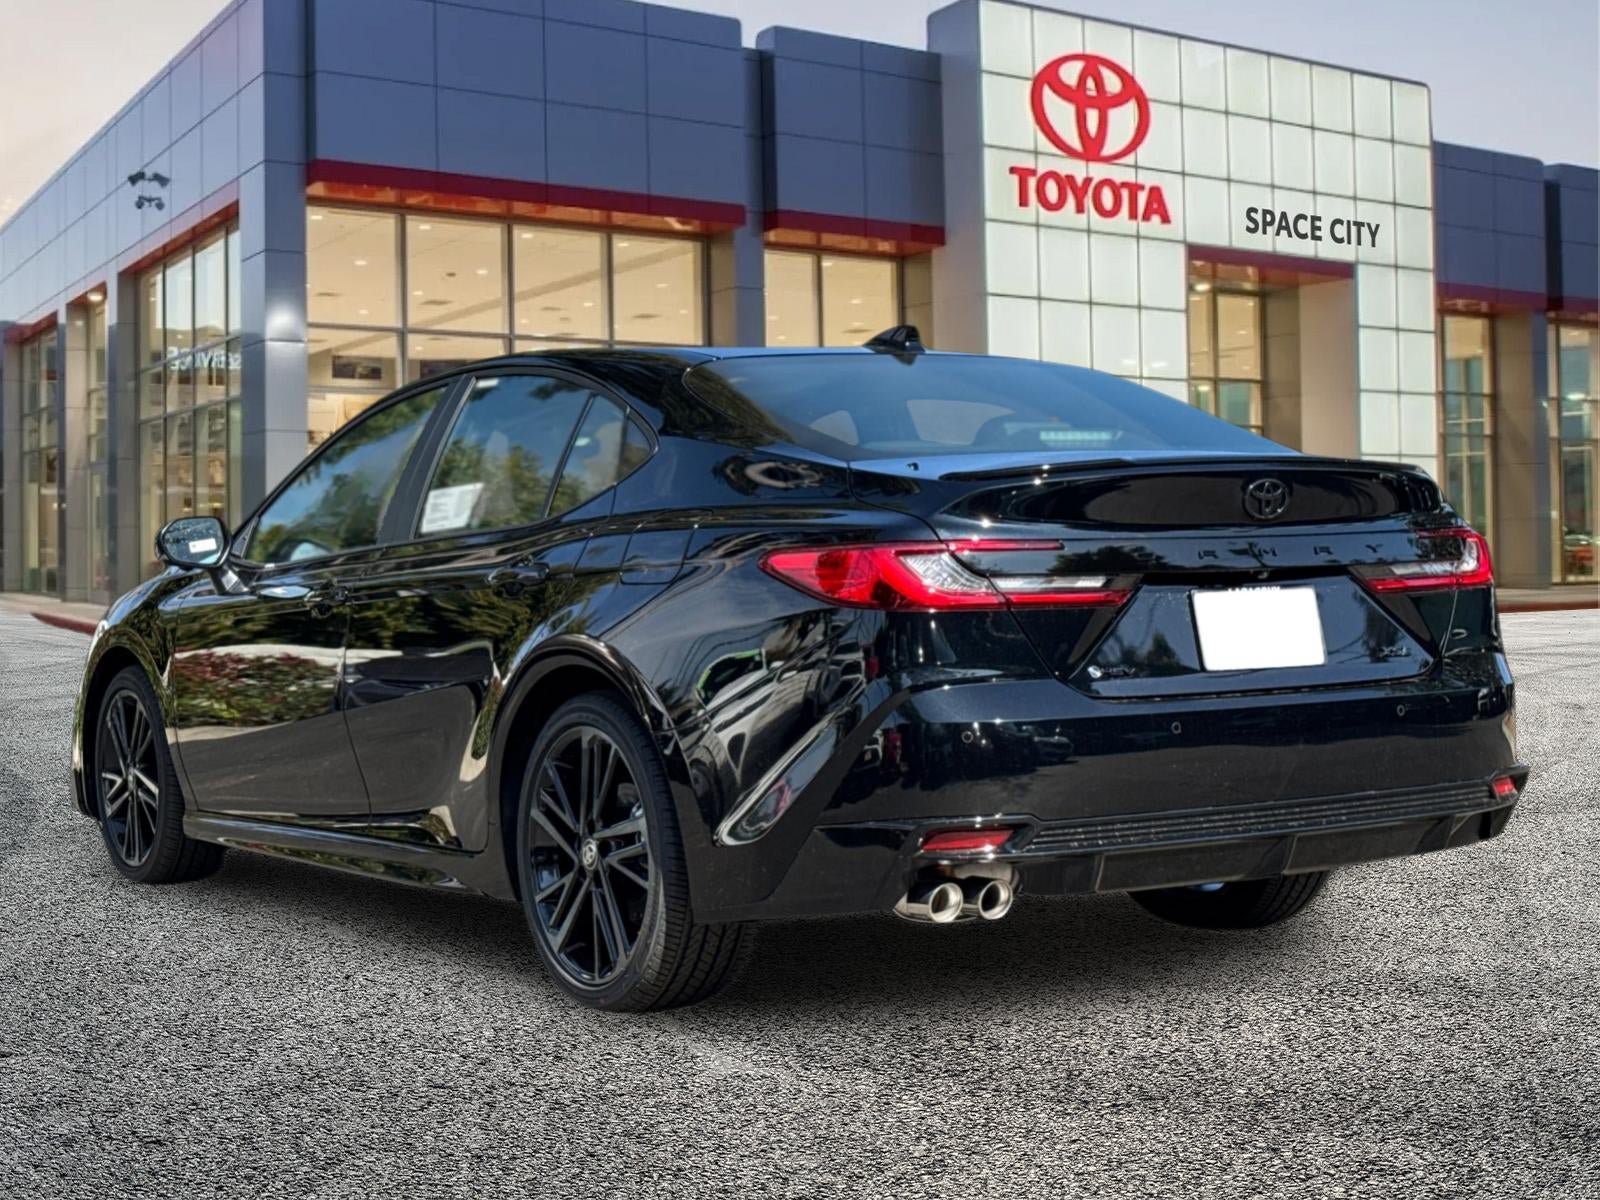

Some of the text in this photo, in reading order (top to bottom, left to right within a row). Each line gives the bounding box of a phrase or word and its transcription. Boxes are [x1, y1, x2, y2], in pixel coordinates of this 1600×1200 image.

[1009, 165, 1171, 224] TOYOTA
[1245, 206, 1380, 247] SPACE CITY
